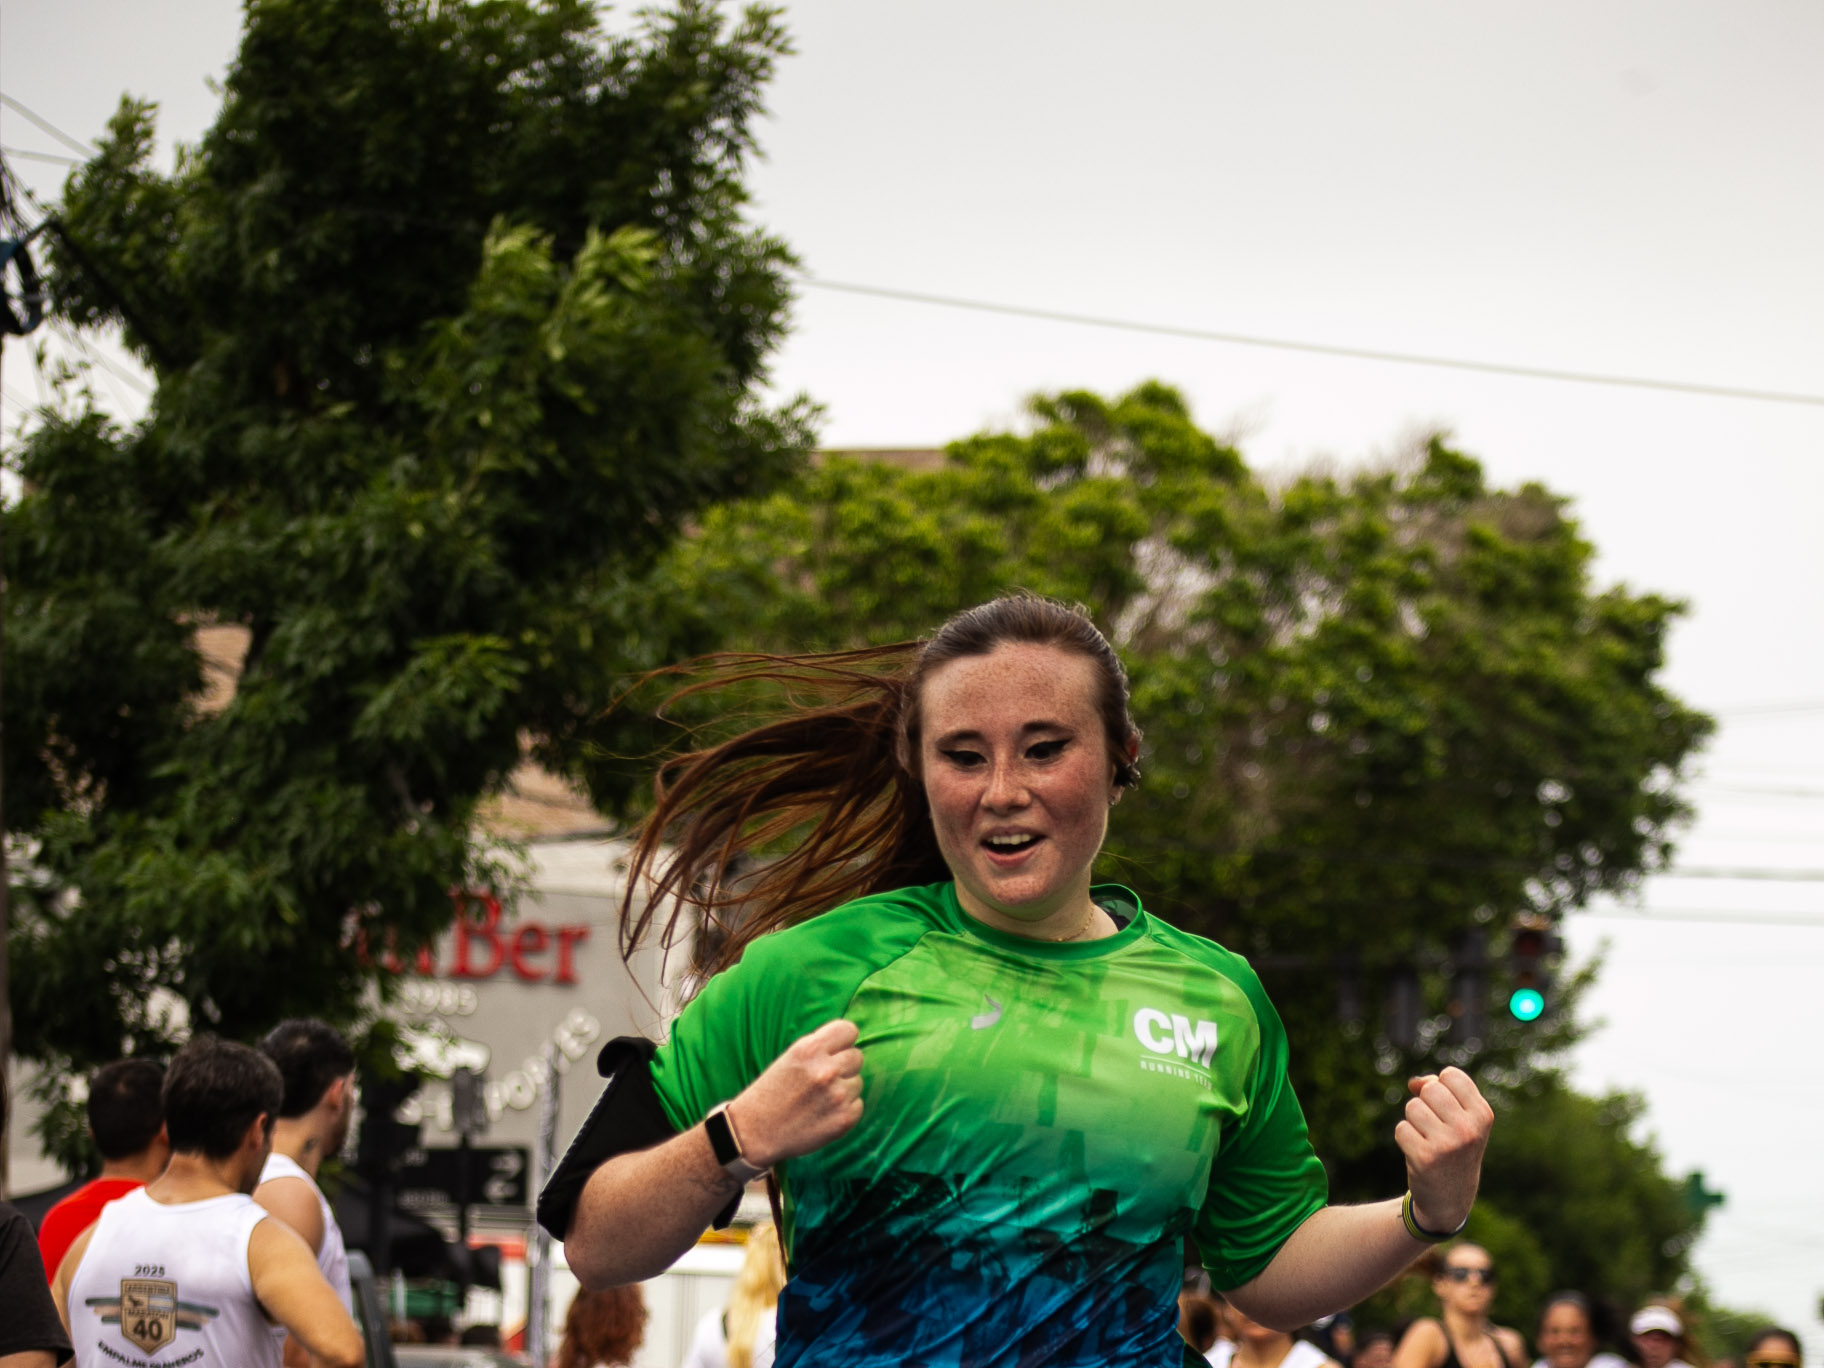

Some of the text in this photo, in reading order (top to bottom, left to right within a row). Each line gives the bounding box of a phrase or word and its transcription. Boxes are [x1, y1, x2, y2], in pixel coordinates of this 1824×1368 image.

[1133, 1007, 1218, 1070] CM
[134, 1264, 166, 1277] 2025
[133, 1319, 163, 1342] 40
